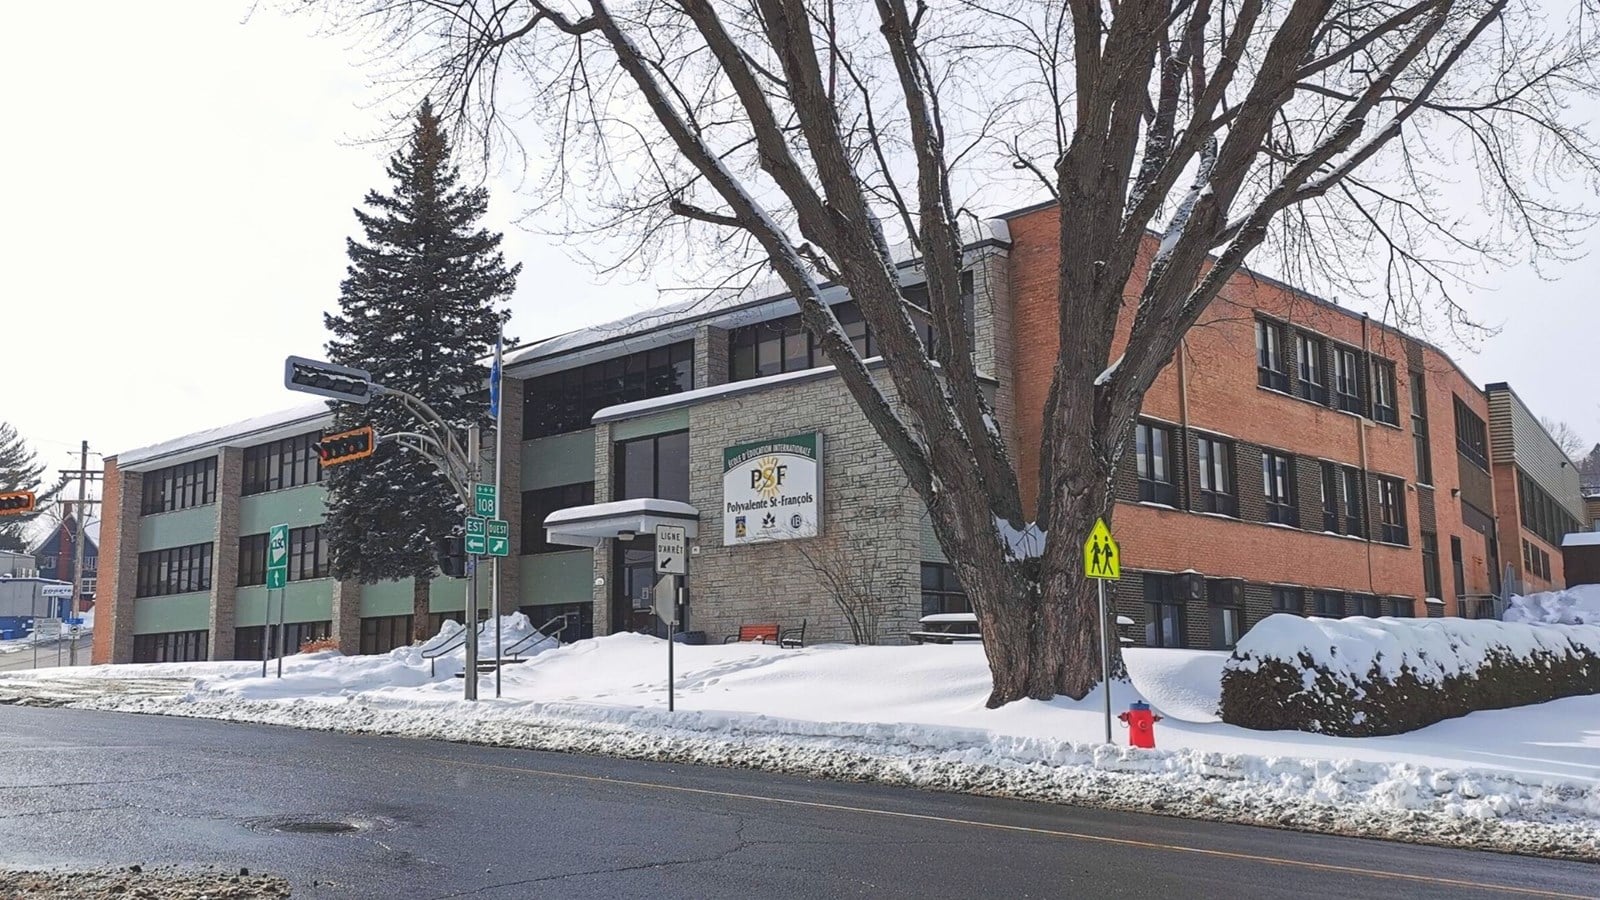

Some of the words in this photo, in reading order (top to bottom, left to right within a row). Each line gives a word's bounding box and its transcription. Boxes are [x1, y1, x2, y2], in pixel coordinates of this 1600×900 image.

[773, 443, 811, 456] INTERNATIONALE
[478, 498, 494, 512] 108
[727, 500, 768, 514] Polyvalente
[769, 492, 813, 507] St-François
[467, 521, 483, 532] EST
[661, 532, 680, 541] LIGNE
